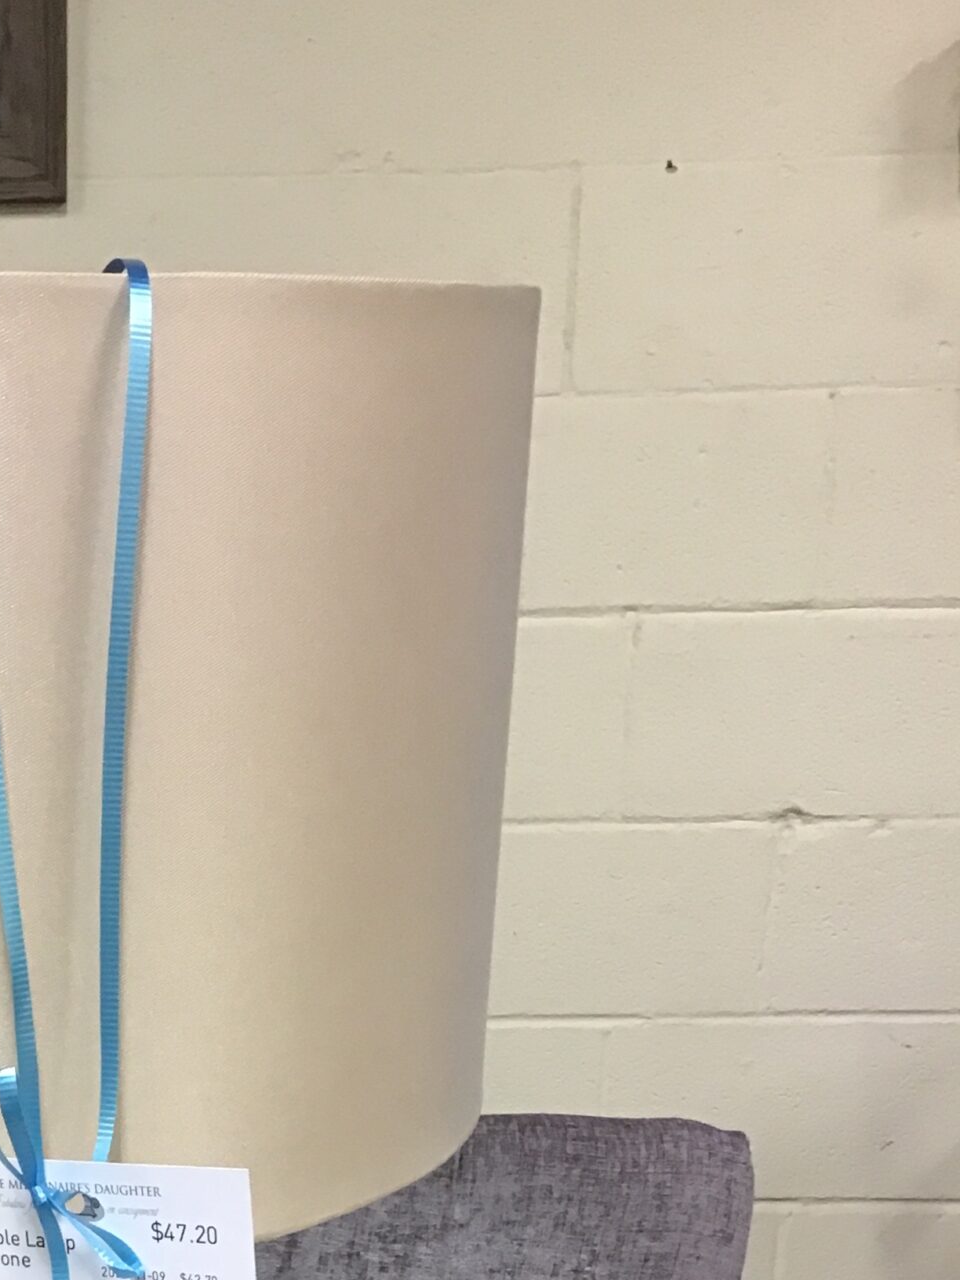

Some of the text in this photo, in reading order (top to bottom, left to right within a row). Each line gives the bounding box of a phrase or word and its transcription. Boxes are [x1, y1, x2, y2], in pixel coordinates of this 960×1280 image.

[94, 1183, 162, 1198] DAUGHTER
[25, 1230, 76, 1254] Lap
[151, 1220, 218, 1245] $47.20
